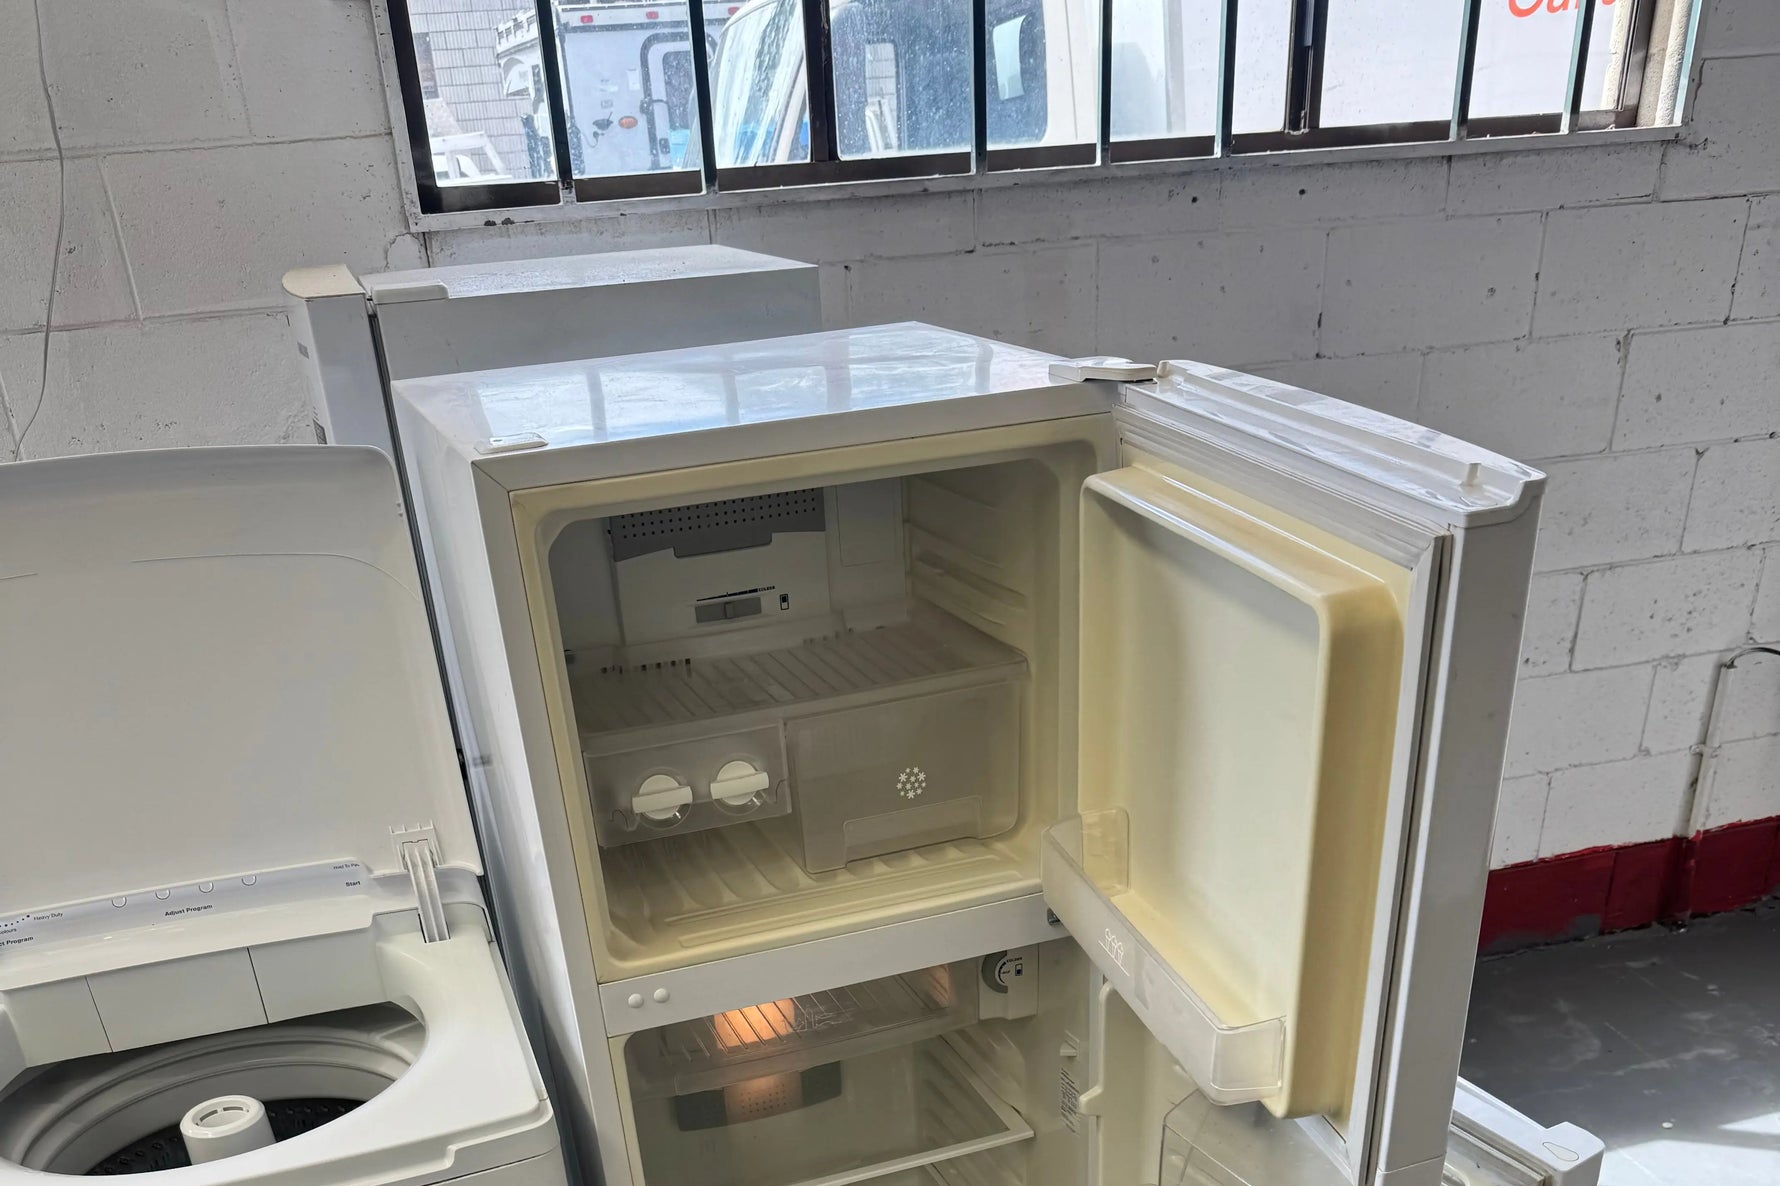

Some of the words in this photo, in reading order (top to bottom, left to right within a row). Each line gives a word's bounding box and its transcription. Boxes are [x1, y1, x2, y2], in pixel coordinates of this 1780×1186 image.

[164, 908, 185, 917] Adjust
[185, 904, 213, 912] Program
[6, 936, 34, 945] Program
